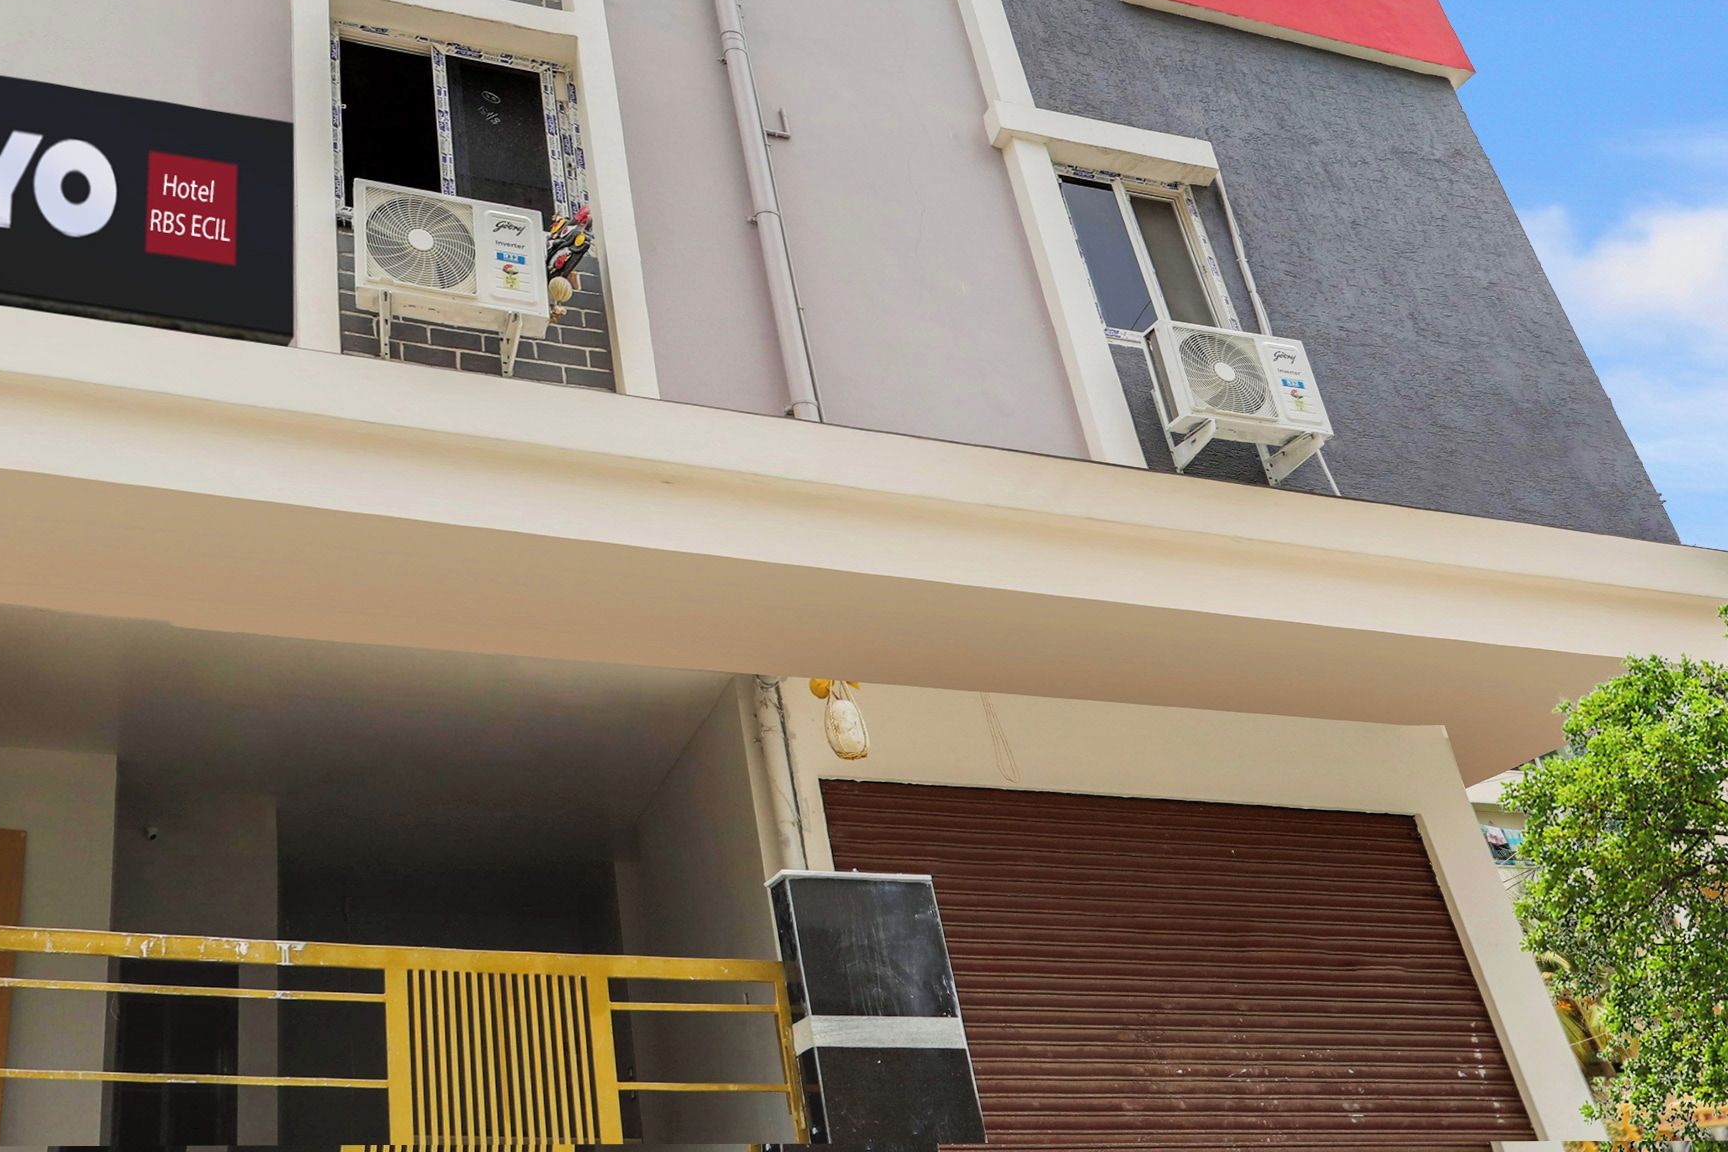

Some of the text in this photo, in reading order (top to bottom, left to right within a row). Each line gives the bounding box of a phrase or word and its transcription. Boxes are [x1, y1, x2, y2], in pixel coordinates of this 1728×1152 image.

[162, 173, 215, 203] Hotel
[150, 208, 231, 242] RBS ECIL
